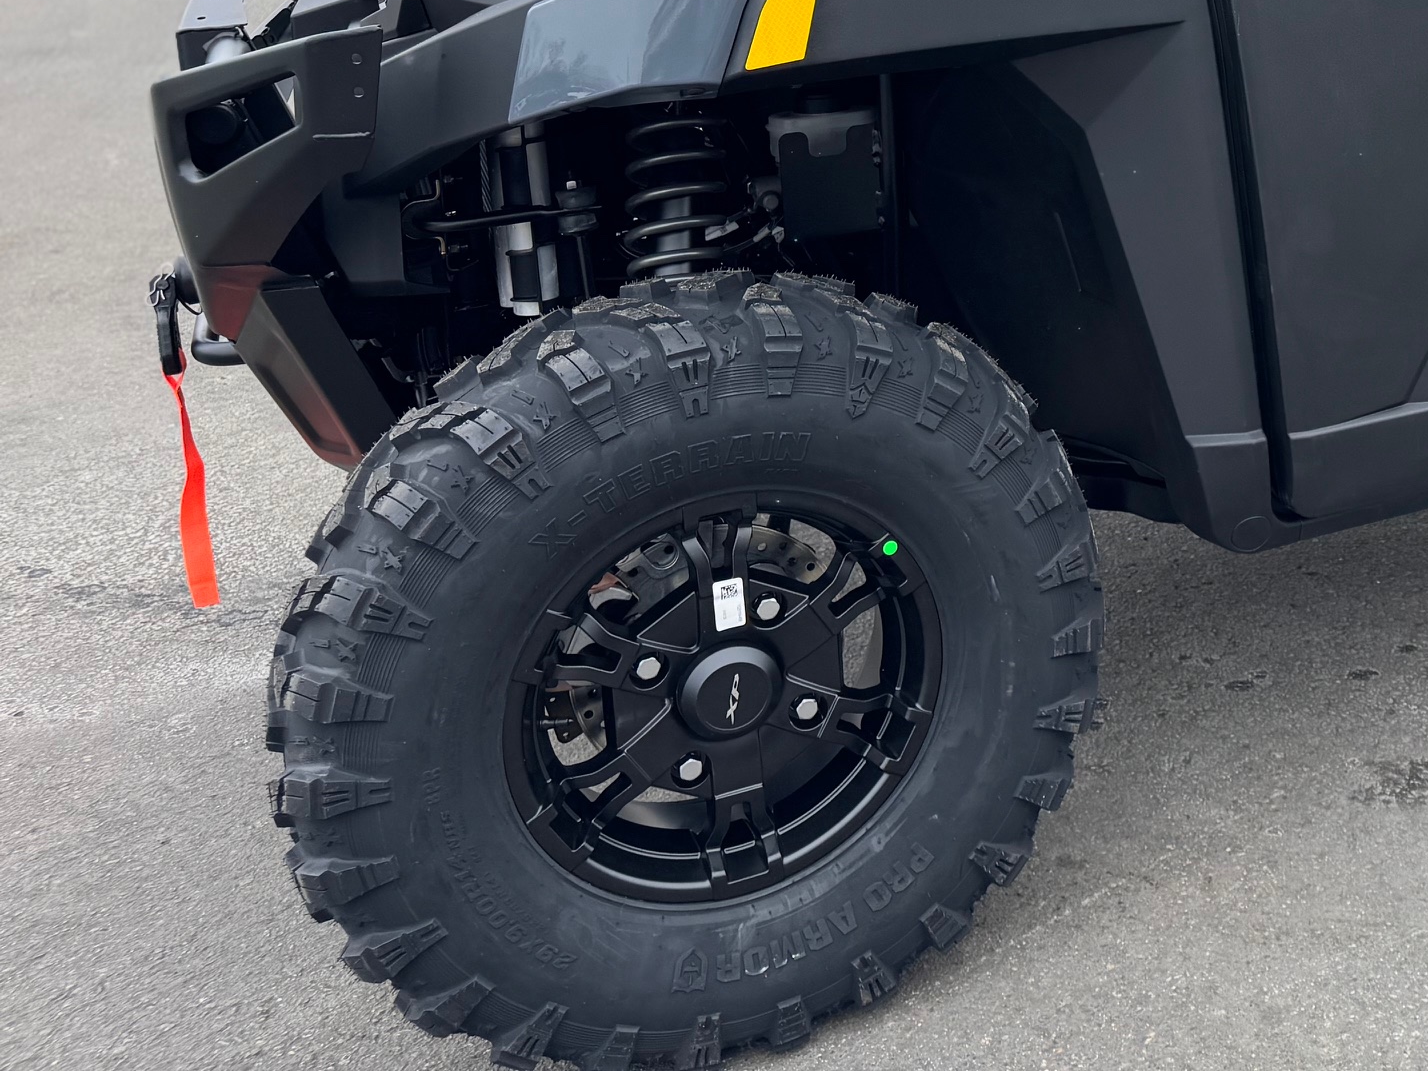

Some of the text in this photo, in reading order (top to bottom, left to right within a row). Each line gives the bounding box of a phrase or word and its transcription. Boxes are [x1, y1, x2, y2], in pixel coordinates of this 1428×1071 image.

[528, 432, 811, 557] X-TERRAIN
[716, 841, 935, 983] PRO ARMOR
